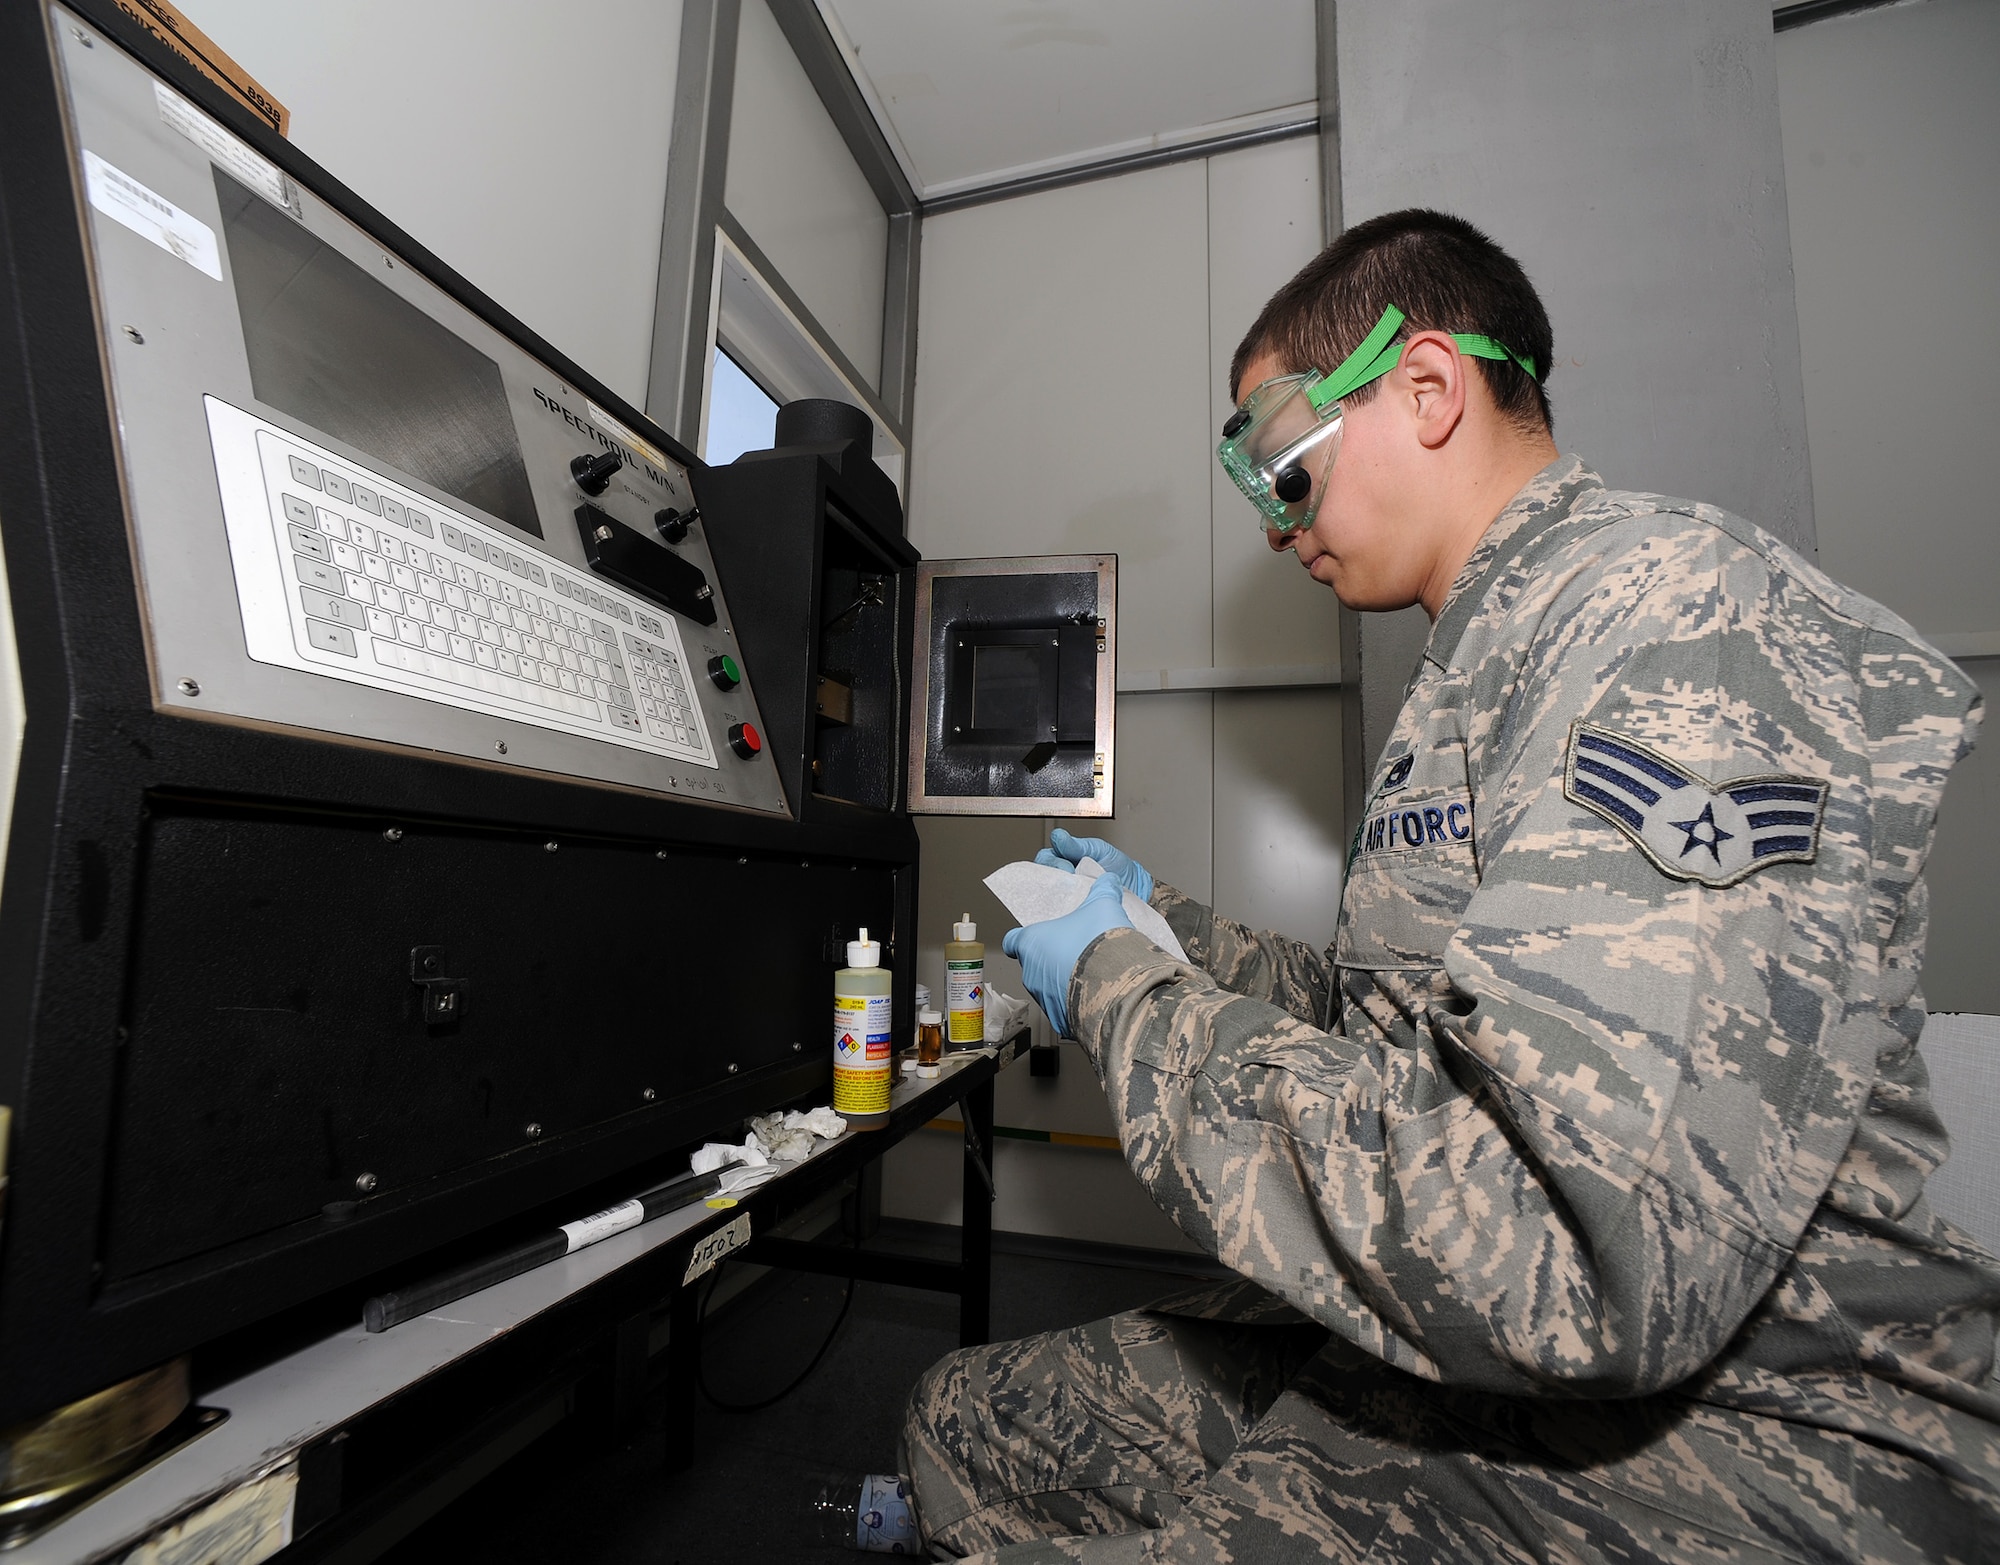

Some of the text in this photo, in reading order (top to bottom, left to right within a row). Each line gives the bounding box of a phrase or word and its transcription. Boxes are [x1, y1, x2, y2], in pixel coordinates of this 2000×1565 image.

[247, 85, 281, 123] 8938
[533, 387, 639, 470] SPECTROIL
[644, 464, 676, 496] M/N
[1365, 803, 1475, 852] AIR FORC
